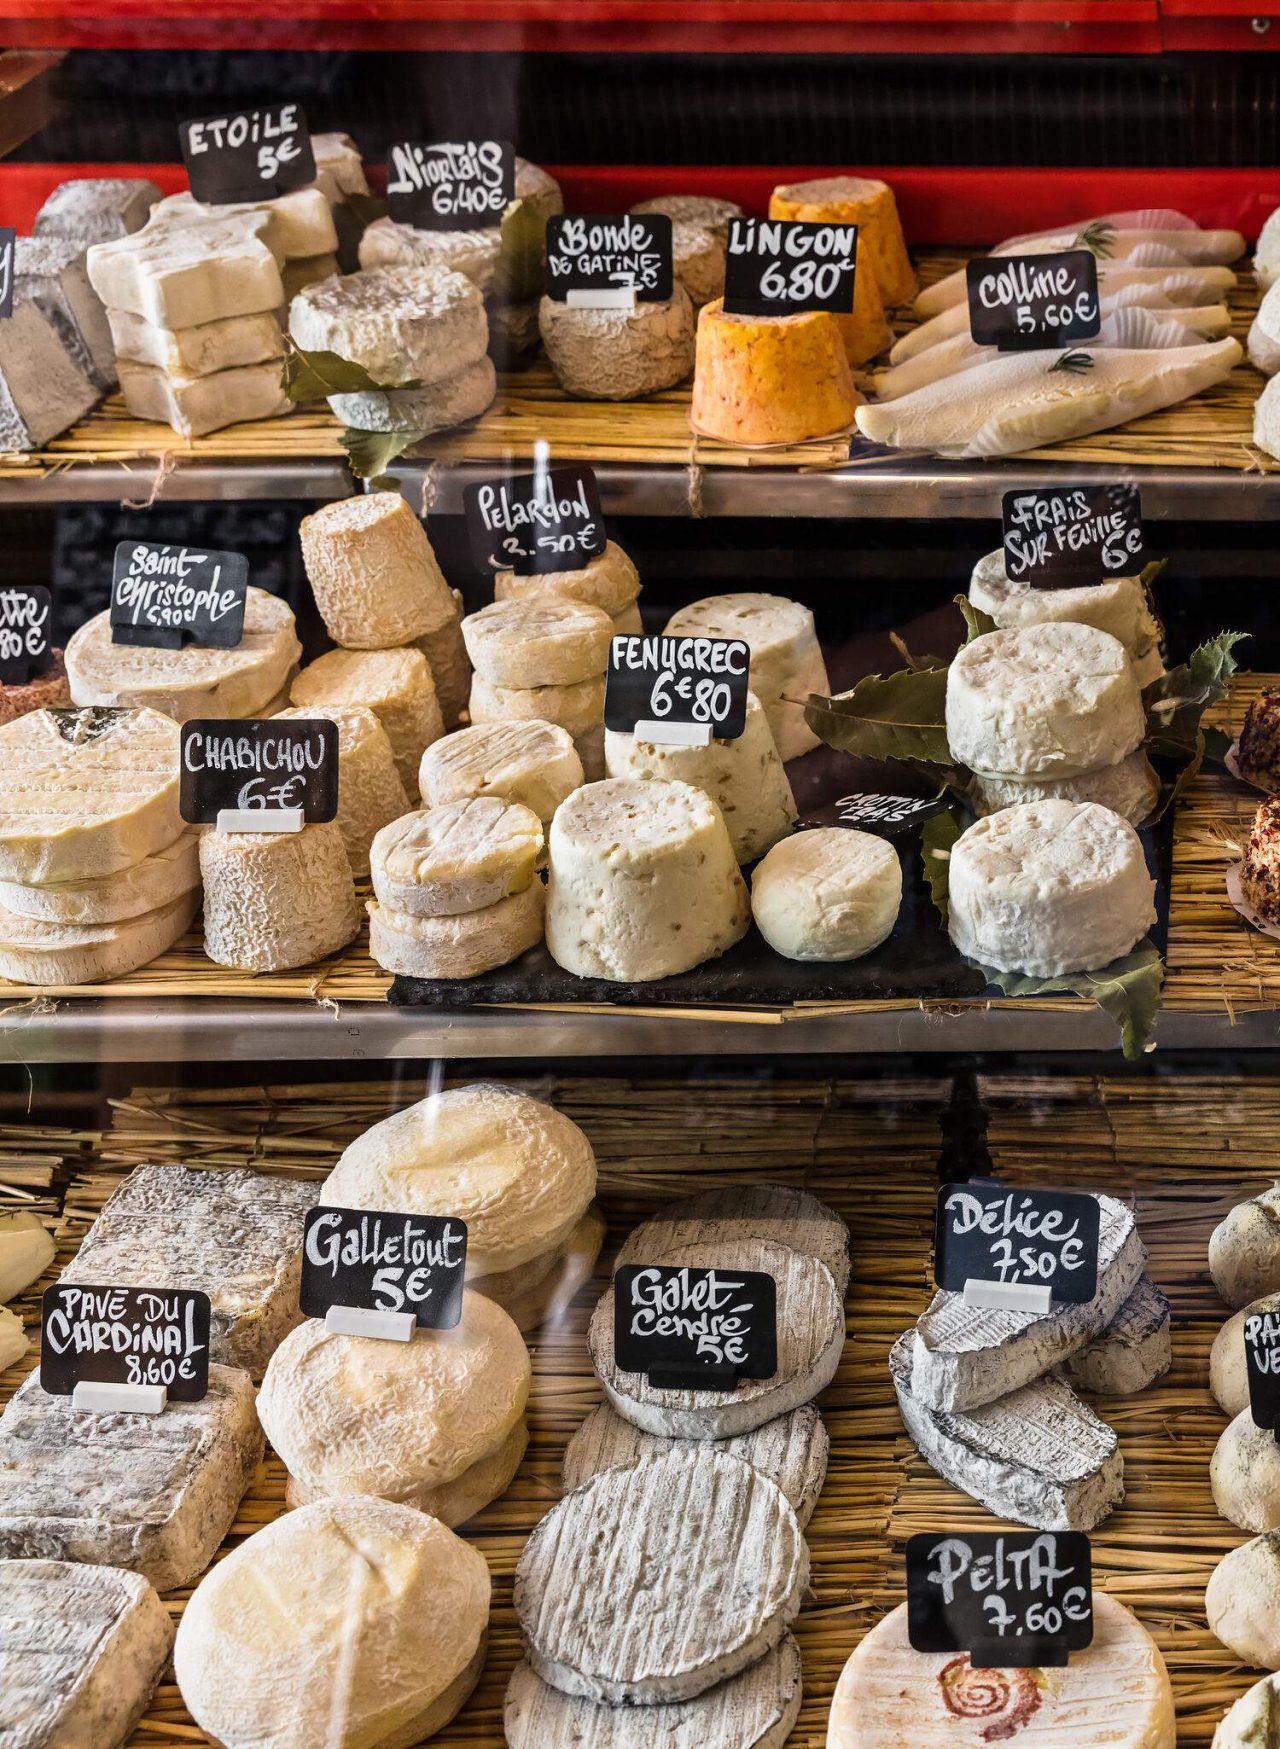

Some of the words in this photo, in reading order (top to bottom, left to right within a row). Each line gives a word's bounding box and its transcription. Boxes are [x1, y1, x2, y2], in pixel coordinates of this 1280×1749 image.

[257, 137, 300, 179] 5€
[432, 183, 507, 215] 6,40€
[558, 215, 653, 256] Bonde
[549, 254, 572, 276] DE
[129, 545, 208, 577] Saint
[1004, 529, 1052, 575] SUR
[1101, 528, 1142, 569] 6€
[116, 565, 242, 625] Christophe
[612, 636, 746, 675] FENUGREC
[185, 733, 325, 772] CHABICHOU
[945, 1193, 1079, 1241] Délice
[305, 1213, 463, 1278] Galletout
[990, 1237, 1085, 1283] 7,50€
[136, 1293, 179, 1322] DU
[371, 1267, 432, 1312] 5€
[631, 1268, 745, 1315] Galet
[125, 1354, 196, 1385] 8,60€
[696, 1335, 749, 1364] 5€
[982, 1586, 1090, 1636] 7,60€
